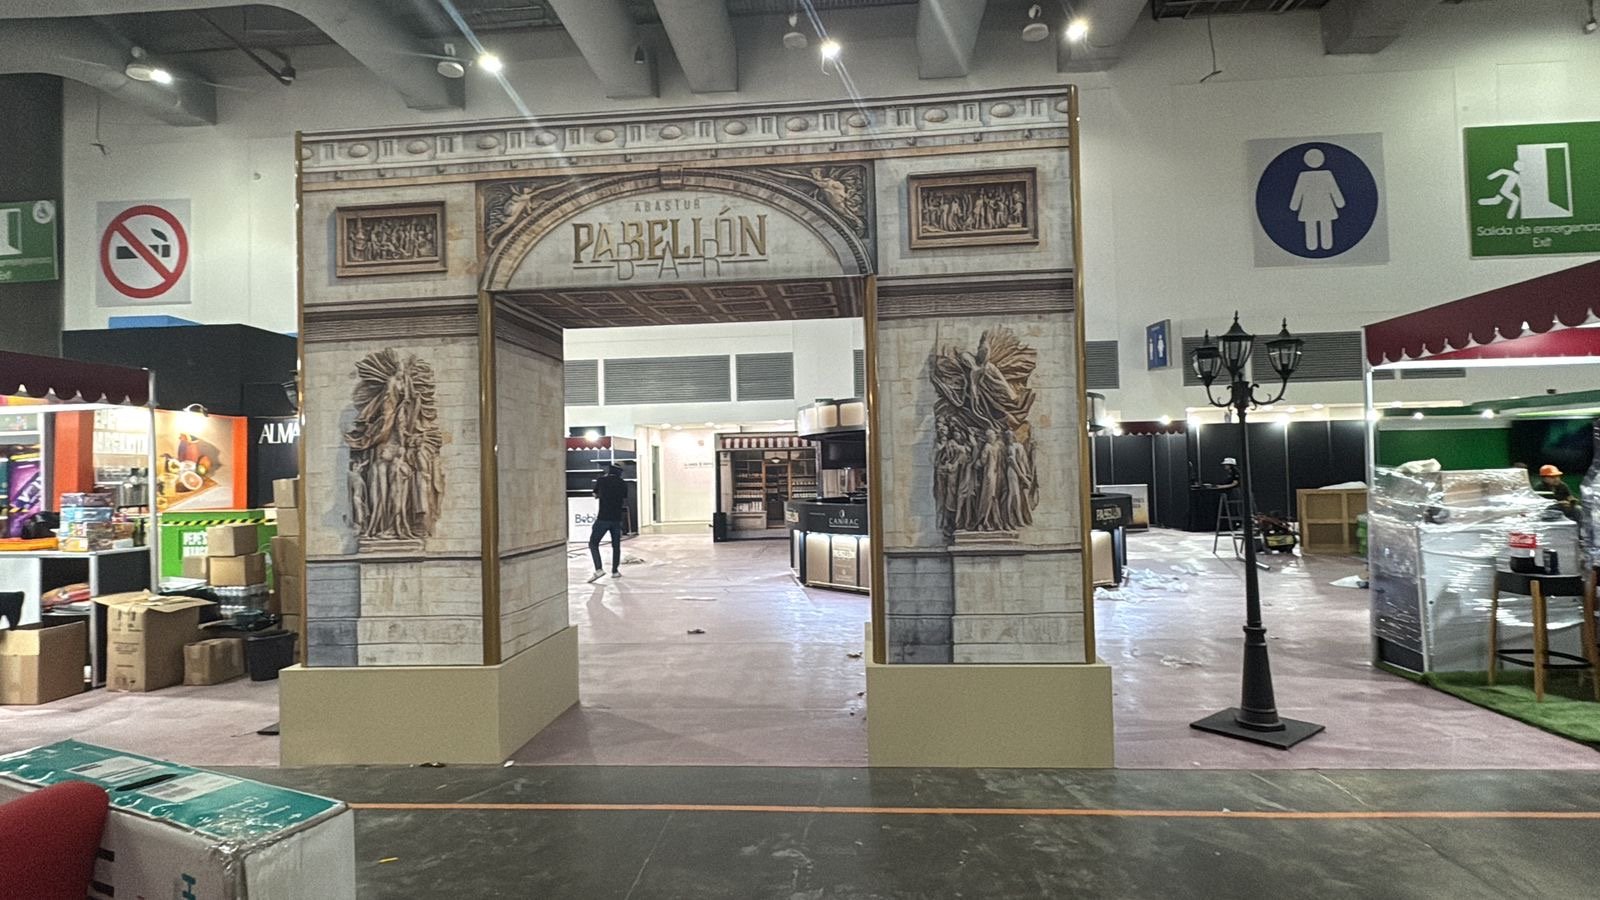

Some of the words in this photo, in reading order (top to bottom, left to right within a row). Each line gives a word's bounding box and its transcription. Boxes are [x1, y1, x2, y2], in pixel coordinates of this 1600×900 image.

[634, 199, 701, 213] ABASTUR
[571, 206, 768, 264] PABELLÓN
[1476, 226, 1513, 237] Salida
[1515, 225, 1532, 235] de
[1532, 237, 1552, 248] Exit
[616, 238, 721, 281] BAR
